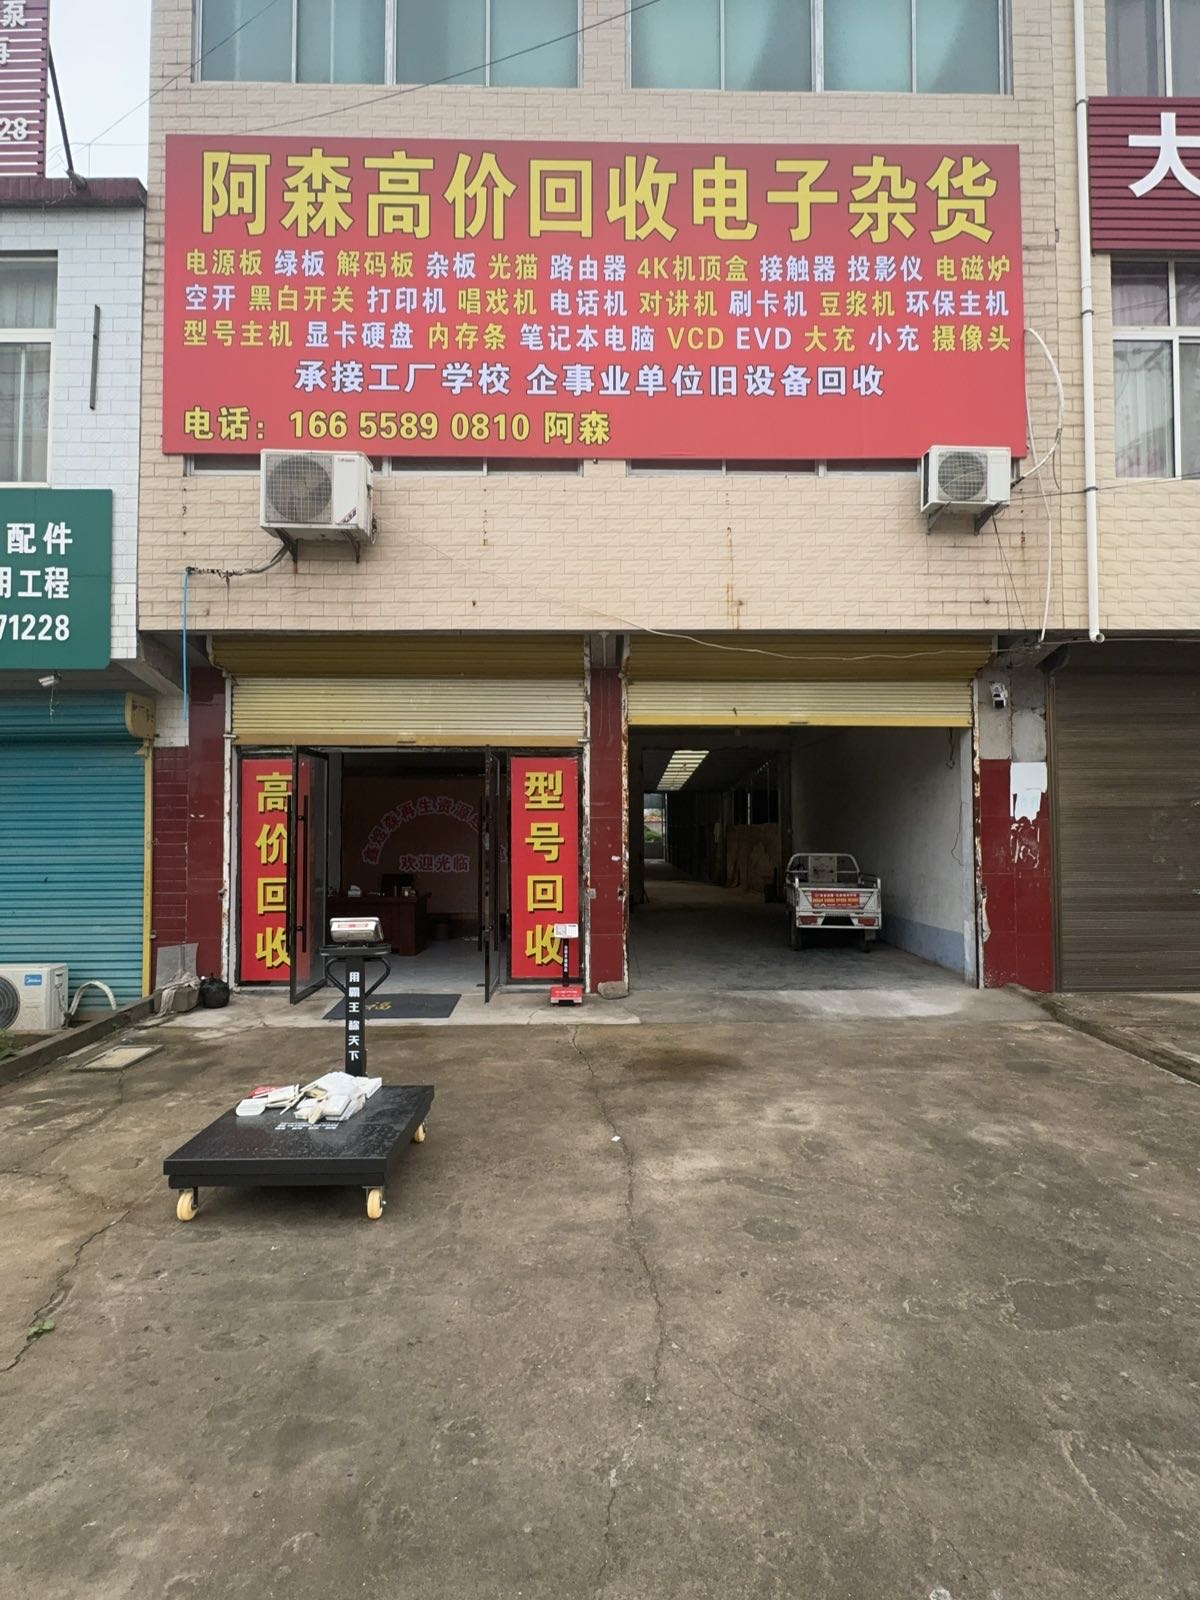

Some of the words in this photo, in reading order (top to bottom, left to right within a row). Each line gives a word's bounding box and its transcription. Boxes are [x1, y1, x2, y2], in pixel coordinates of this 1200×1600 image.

[2, 0, 27, 28] 泵
[1128, 112, 1200, 198] 大
[202, 148, 997, 243] 阿森高价回收电子杂货
[186, 248, 263, 276] 电源板
[274, 248, 325, 277] 绿板
[336, 249, 414, 278] 解码板
[426, 251, 477, 280] 杂板
[488, 252, 538, 281] 光猫
[549, 253, 627, 282] 路由器
[637, 254, 749, 282] 4K机顶盒
[759, 254, 836, 283] 接触器
[847, 254, 923, 283] 投影仪
[936, 254, 1010, 282] 电磁炉
[185, 283, 236, 312] 空开
[248, 284, 354, 313] 黑白开关
[366, 285, 447, 314] 打印机
[458, 287, 538, 316] 唱戏机
[550, 288, 628, 317] 电话机
[639, 289, 718, 317] 对讲机
[728, 289, 808, 318] 刷卡机
[819, 290, 896, 318] 豆浆机
[905, 289, 1009, 317] 环保主机
[183, 319, 293, 348] 型号主机
[305, 320, 414, 349] 显卡硬盘
[428, 321, 506, 351] 内存条
[519, 323, 655, 353] 笔记本电脑
[666, 326, 724, 350] VCD
[736, 326, 792, 350] EVD
[804, 324, 856, 352] 大充
[868, 324, 920, 353] 小充
[932, 324, 1011, 352] 摄像头
[294, 360, 510, 395] 承接工厂学校
[526, 363, 884, 397] 企事业单位旧设备回收
[184, 406, 264, 440] 电话：
[290, 411, 347, 438] 166
[359, 412, 438, 439] 5589
[451, 413, 530, 441] 0810
[544, 410, 610, 445] 阿森
[6, 521, 73, 555] 配件
[255, 771, 292, 968] 高价回收
[524, 769, 565, 966] 型号回收
